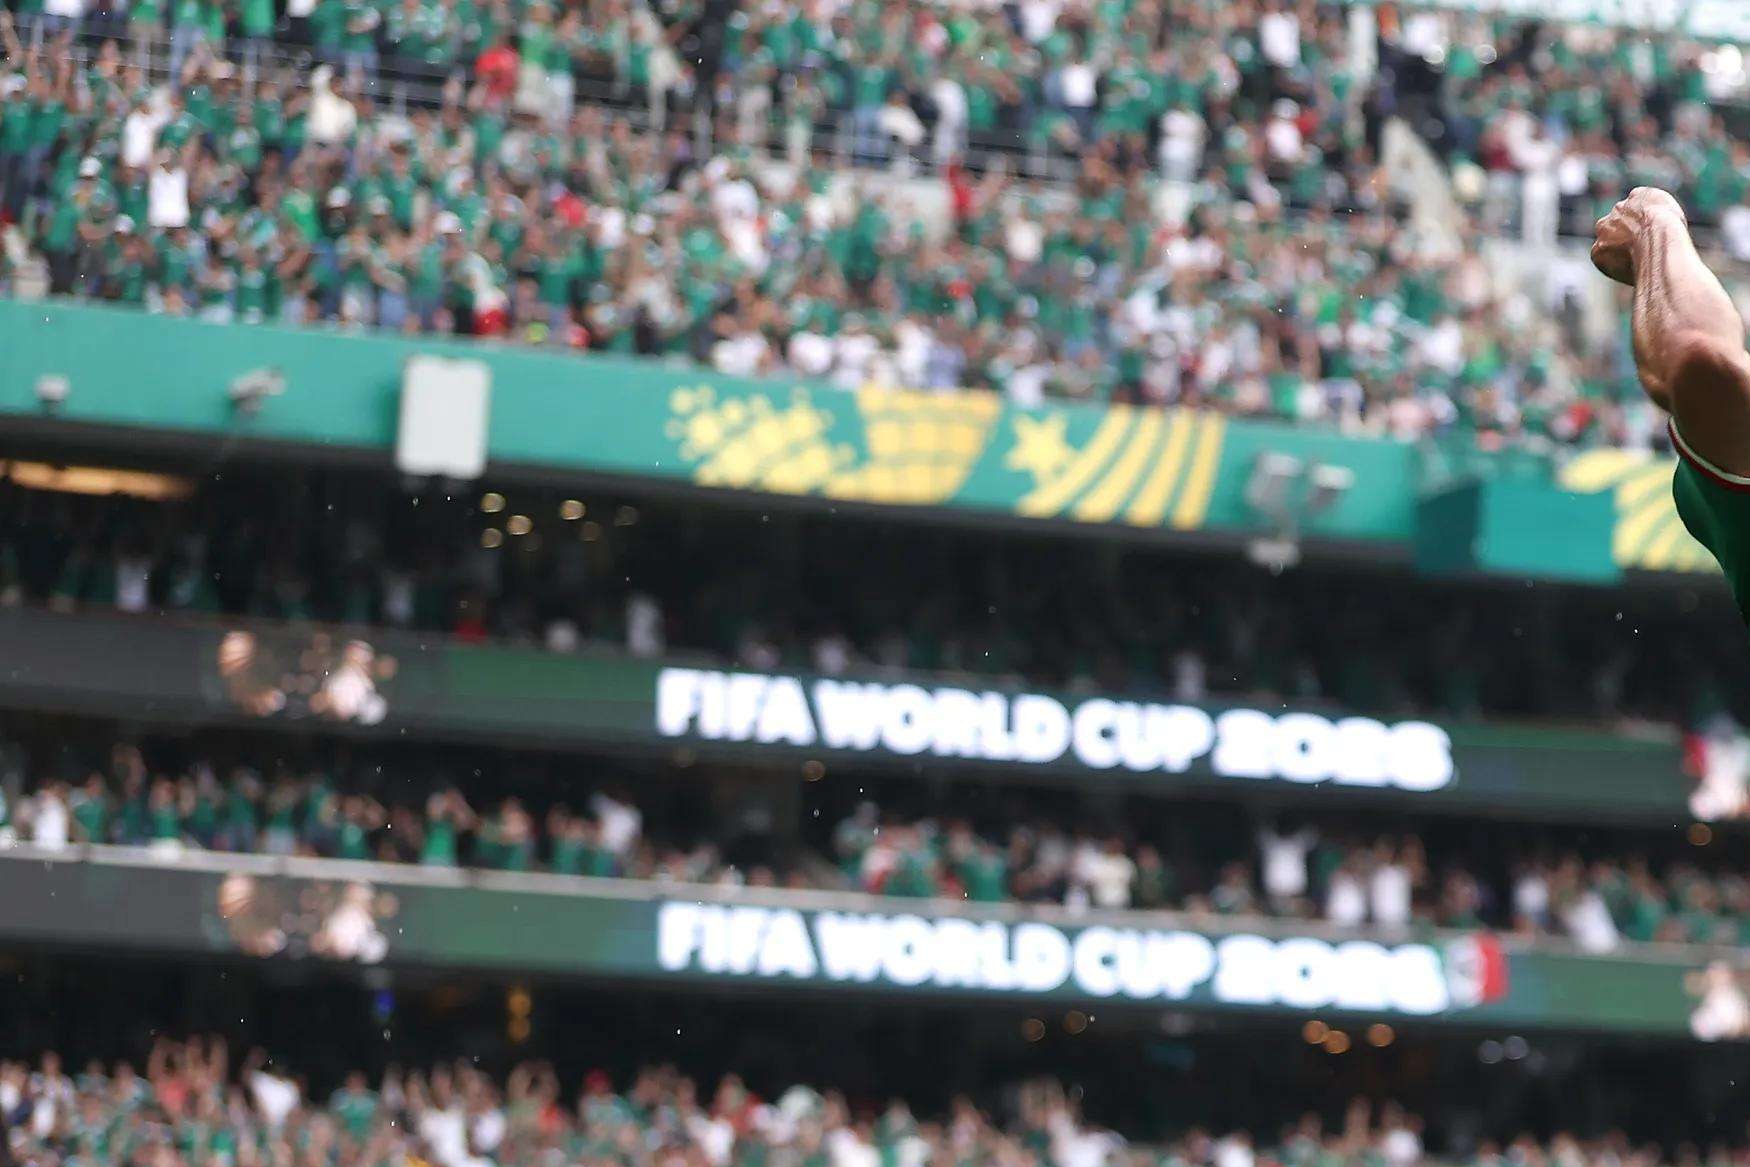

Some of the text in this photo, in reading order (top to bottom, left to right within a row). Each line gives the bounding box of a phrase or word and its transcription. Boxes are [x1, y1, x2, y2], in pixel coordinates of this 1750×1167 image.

[657, 668, 814, 746] FIFA
[817, 680, 1071, 763] WORLD
[1073, 699, 1212, 771] CUP
[658, 902, 815, 975] FIFA
[818, 912, 1071, 992] WORLD
[1073, 928, 1212, 998] CUP
